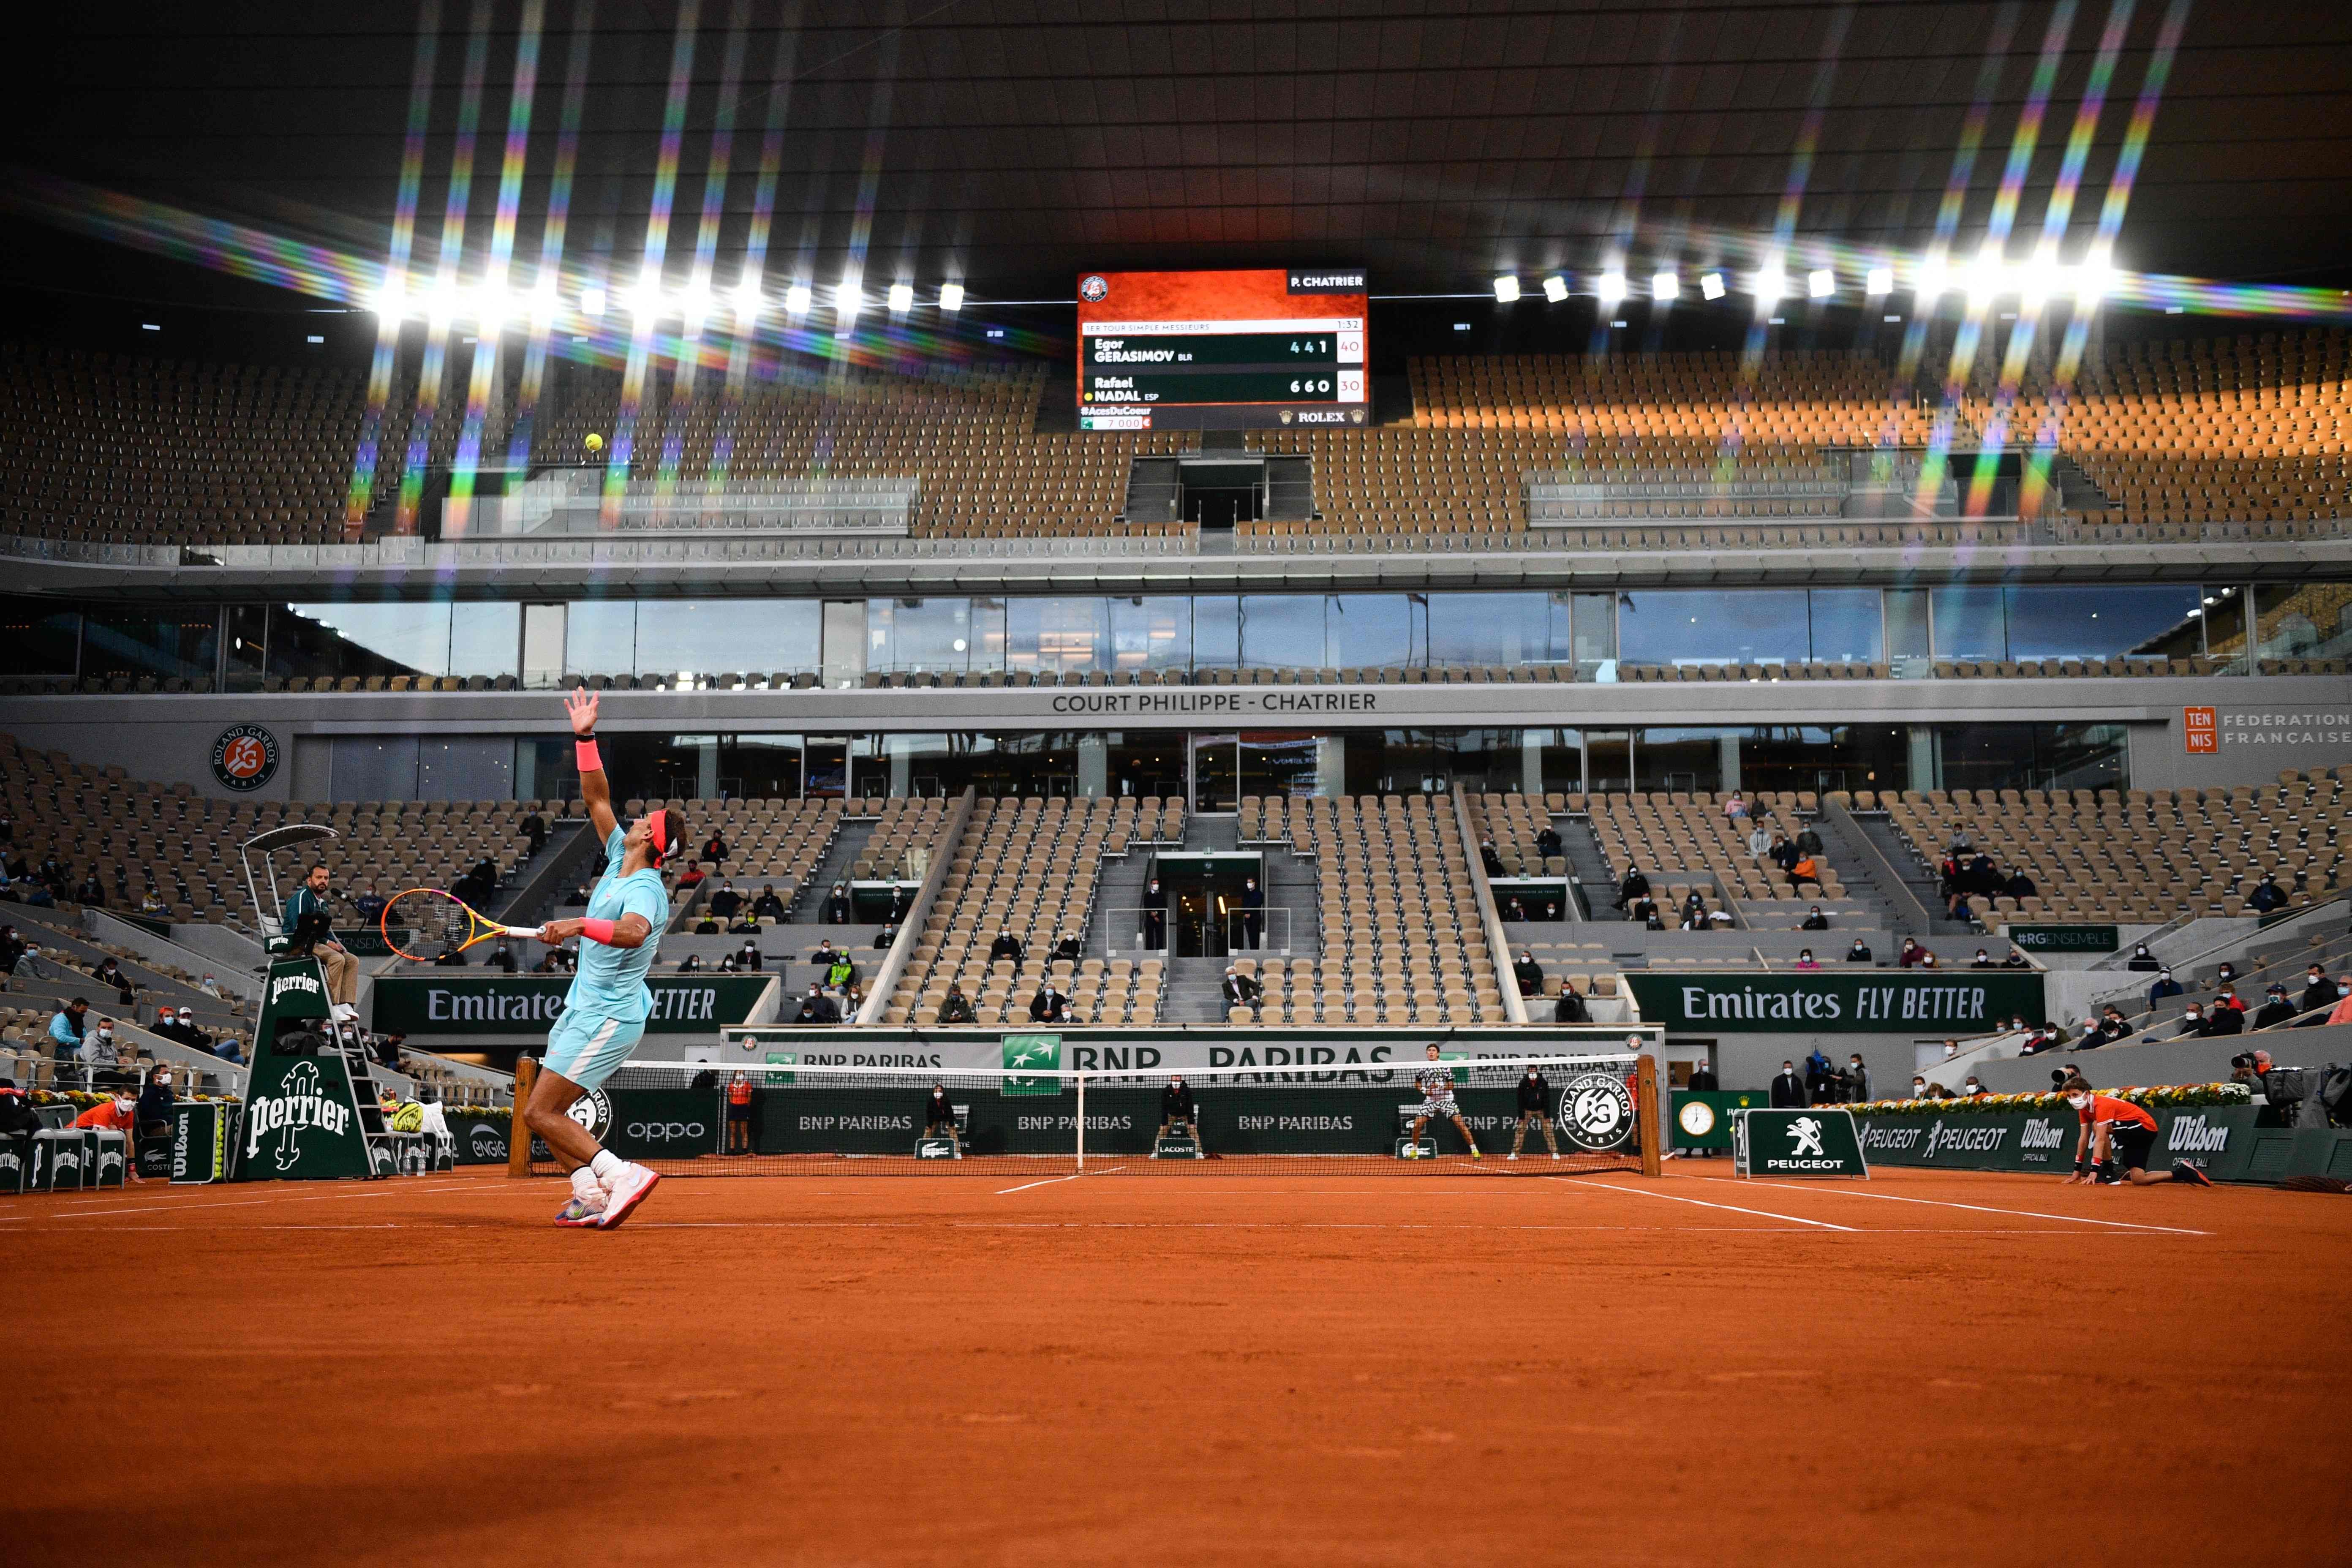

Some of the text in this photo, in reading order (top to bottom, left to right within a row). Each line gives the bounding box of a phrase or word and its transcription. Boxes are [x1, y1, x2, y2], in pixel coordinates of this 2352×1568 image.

[1291, 276, 1363, 287] P. CHATRIER
[1095, 339, 1124, 351] Egor
[1290, 341, 1359, 353] 4 4 1 40
[1094, 351, 1175, 362] GERASIMOV
[1095, 377, 1133, 388] Rafael
[1290, 380, 1359, 393] 6 6 0 30
[1095, 391, 1141, 401] NADAL
[1081, 407, 1152, 415] #AcesDuCoeur
[1298, 412, 1345, 422] ROLEX
[1053, 695, 1131, 713] COURT
[1139, 694, 1241, 712] PHILIPPE
[1263, 693, 1376, 711] CHATRIER
[2188, 713, 2210, 725] TEN
[2191, 734, 2212, 747] NIS
[2225, 732, 2352, 745] FRANÇAISE
[215, 727, 275, 765] ROLAND GARROS
[223, 774, 265, 787] PARIS
[269, 935, 289, 950] perrier
[2017, 933, 2110, 945] #RGENSEMBLE
[272, 972, 319, 1004] perrier
[428, 988, 716, 1020] Emirate ETTER
[1682, 986, 1985, 1019] Emirates FLY BETTER
[1073, 1045, 1394, 1082] BNP PARIBAS
[1565, 1078, 1631, 1122] ROLAND GARROS
[593, 1092, 607, 1123] RROS
[246, 1087, 349, 1159] perrier
[800, 1116, 912, 1130] BNP PARIBAS
[1018, 1116, 1132, 1130] BNP PARIBAS
[1239, 1116, 1353, 1130] BNP PARIBAS
[627, 1122, 705, 1142] oppo
[1576, 1127, 1622, 1143] PARIS
[1866, 1129, 1922, 1149] PEUGEOT
[2020, 1118, 2063, 1149] Wilson
[2168, 1115, 2228, 1151] Wilson
[174, 1111, 189, 1178] Wilson
[1938, 1128, 2008, 1151] PEUGEOT
[0, 1149, 20, 1171] rrier
[100, 1148, 122, 1179] perrier
[1767, 1159, 1844, 1169] PEUGEOT
[2039, 1154, 2049, 1162] BALL
[2195, 1158, 2208, 1167] BALL
[54, 1148, 79, 1183] perrier
